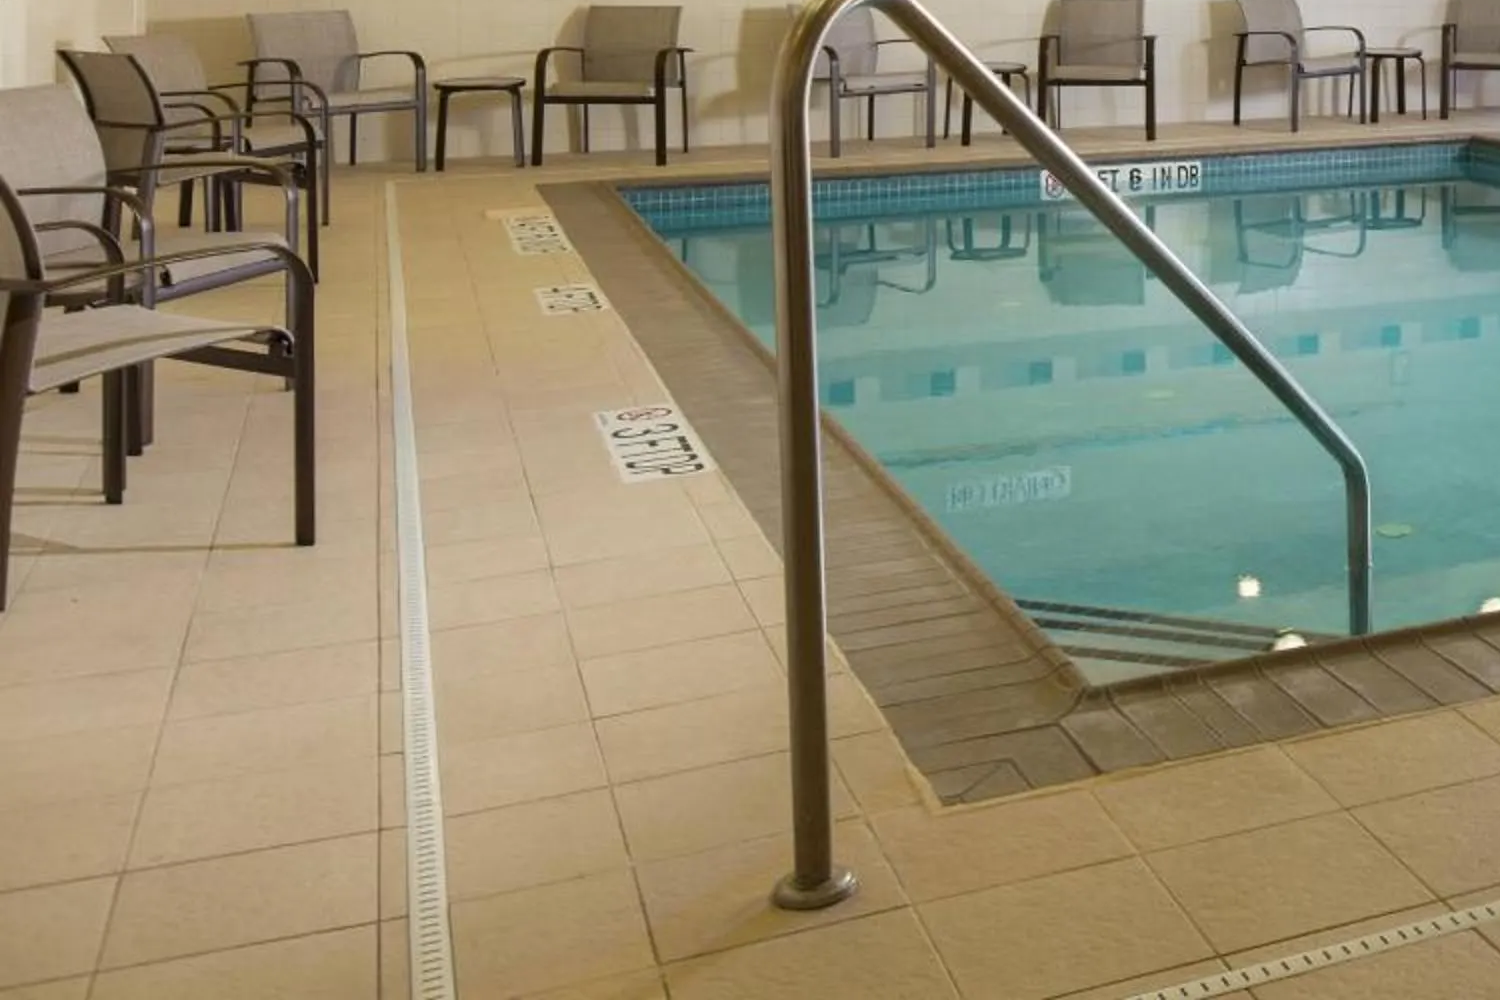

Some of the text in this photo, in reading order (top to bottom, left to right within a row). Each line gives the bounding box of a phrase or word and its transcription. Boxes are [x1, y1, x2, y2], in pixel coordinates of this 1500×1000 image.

[1152, 166, 1172, 191] IN
[611, 423, 679, 439] 3
[615, 436, 693, 459] FT
